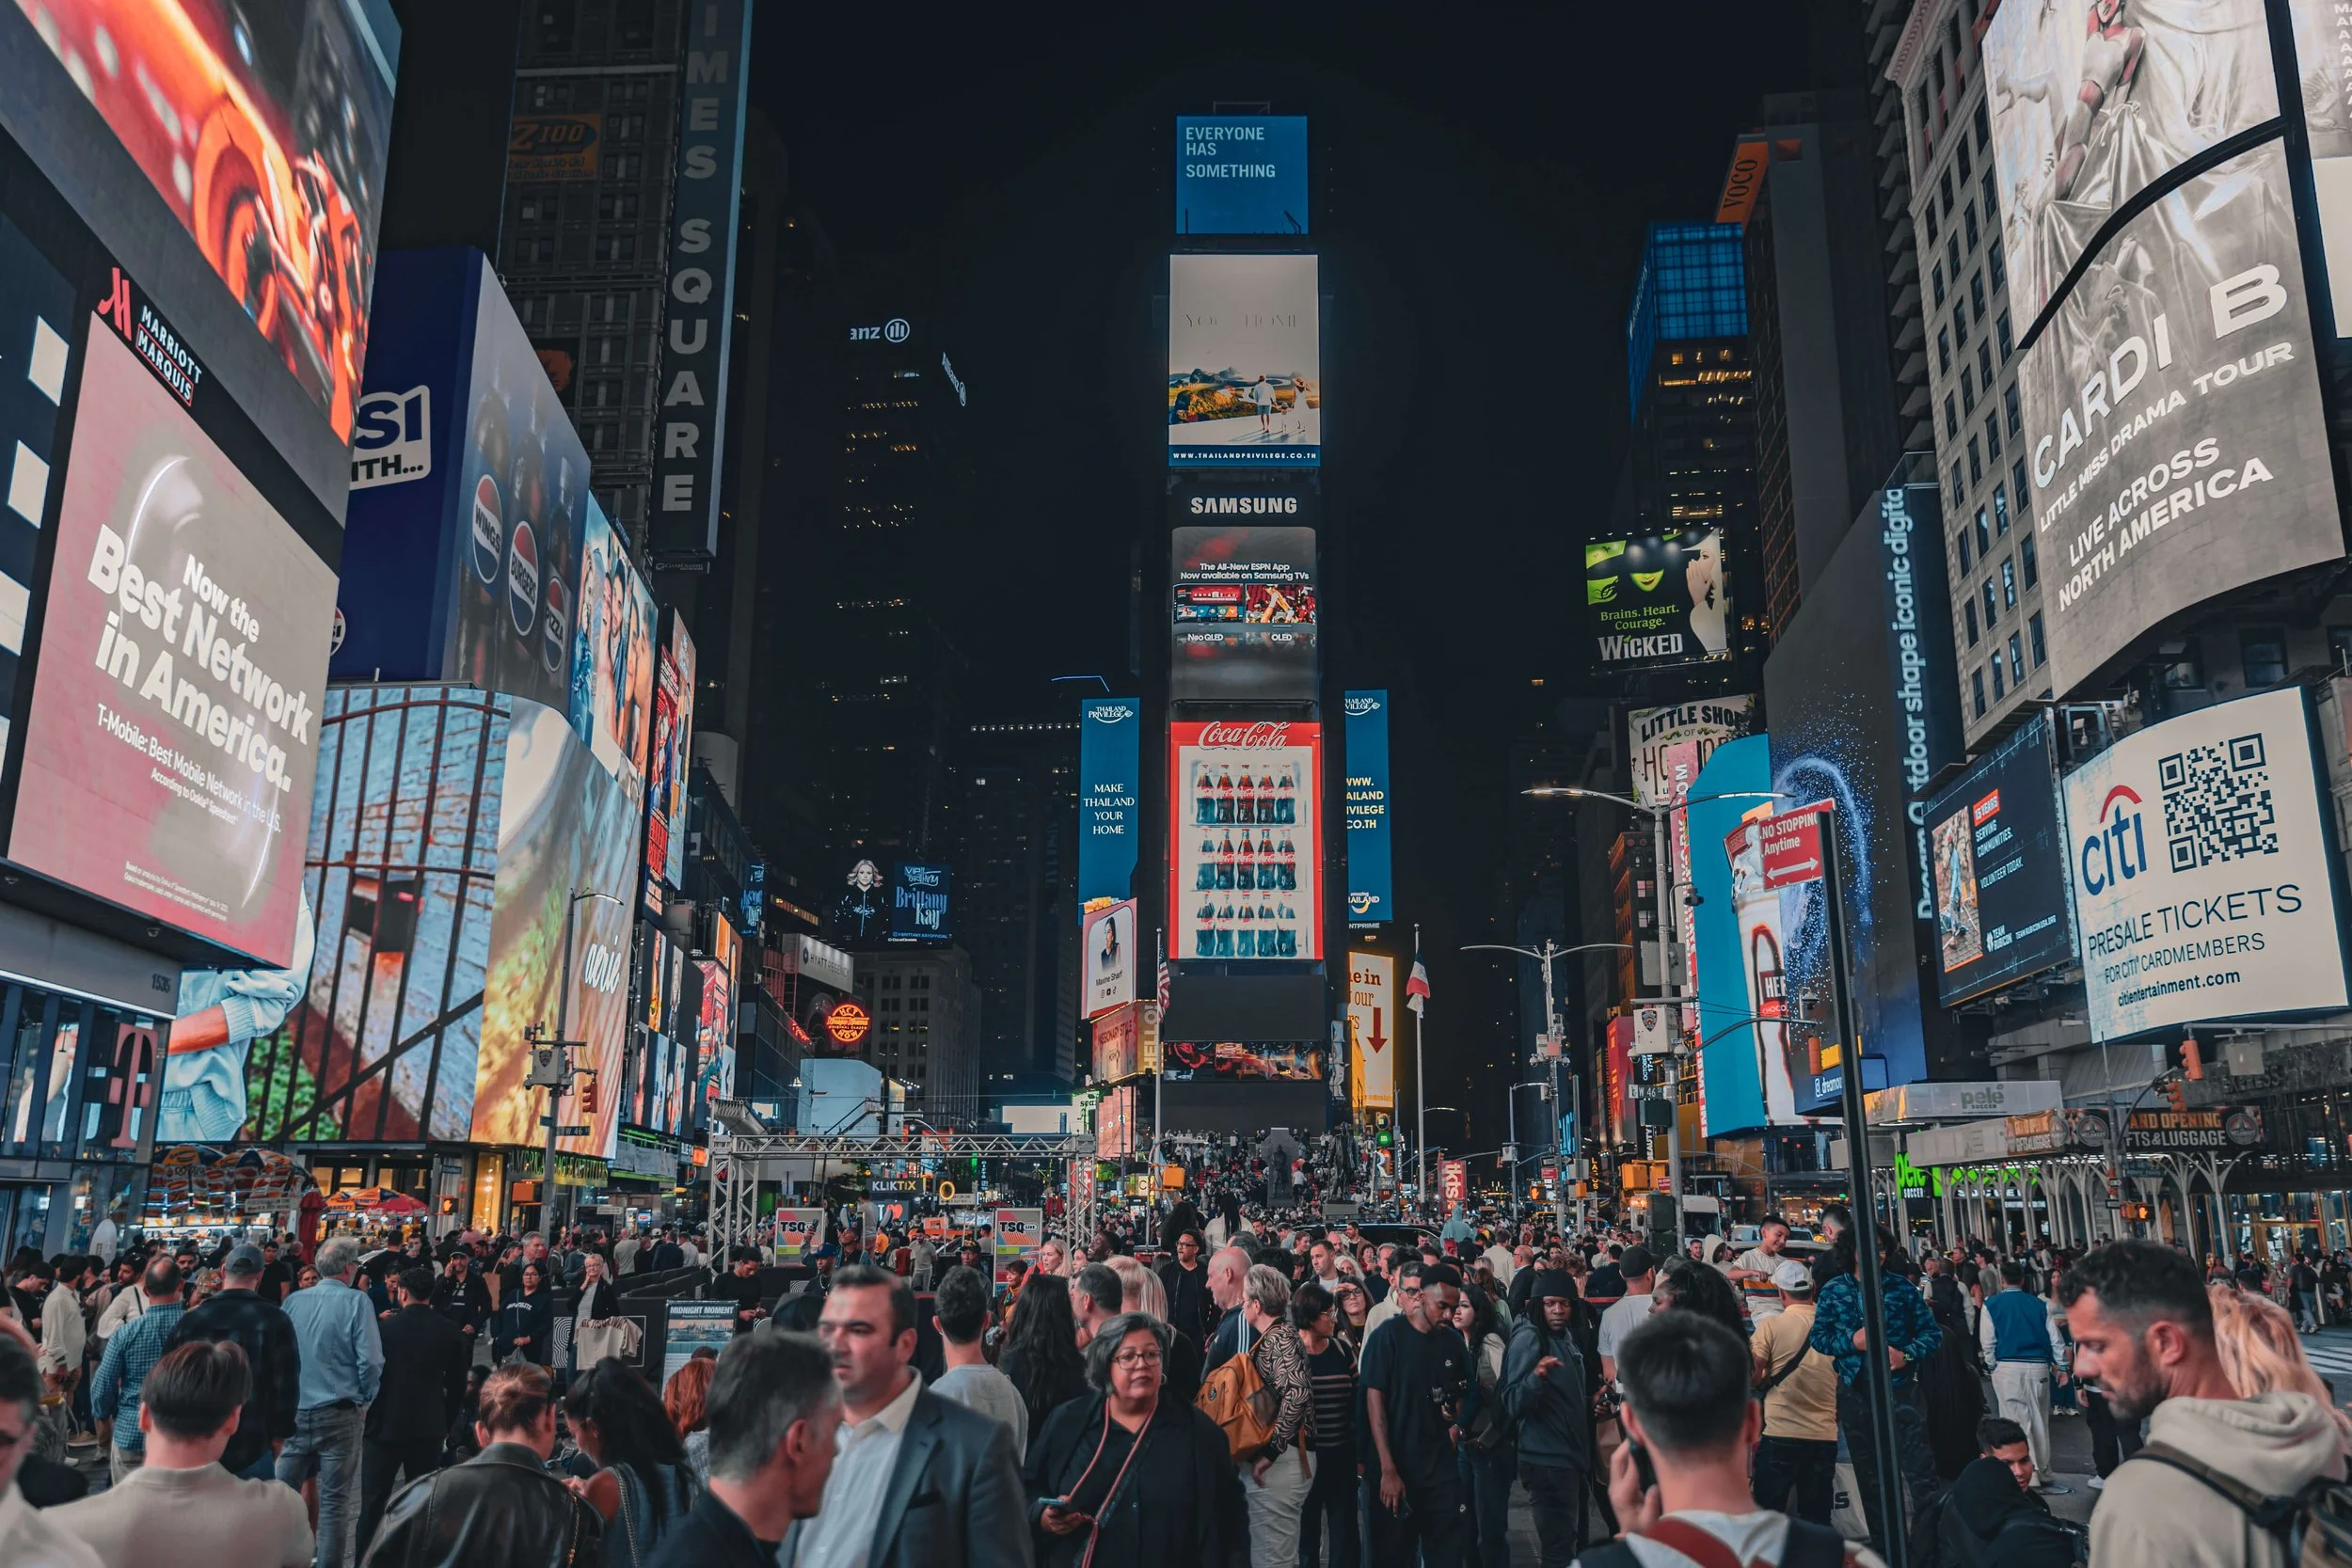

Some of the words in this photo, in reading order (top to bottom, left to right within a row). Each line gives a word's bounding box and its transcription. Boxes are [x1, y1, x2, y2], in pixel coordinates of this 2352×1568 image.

[1185, 127, 1264, 140] EVERYONE
[1185, 142, 1216, 156] HAS
[1185, 164, 1276, 178] SOMETHING
[140, 304, 202, 384] MARRIOTT
[136, 332, 193, 400] MARQUIS
[662, 218, 713, 511] SQUARE
[2033, 313, 2172, 488] CARDI
[2209, 263, 2287, 341] B
[2040, 483, 2077, 532] LITTLE
[2078, 447, 2108, 491] MISS
[2110, 390, 2187, 456] DRAMA
[2192, 341, 2295, 397] TOUR
[1190, 497, 1297, 514] SAMSUNG
[2070, 513, 2106, 568] LIVE
[2107, 436, 2220, 531] ACROSS
[475, 501, 501, 555] WINGS
[2058, 547, 2115, 612] NORTH
[2120, 457, 2274, 558] AMERICA
[511, 550, 537, 606] BURGERS
[1200, 562, 1216, 571] The
[1216, 562, 1249, 571] All-New
[1251, 562, 1271, 571] ESPN
[1272, 562, 1290, 573] App
[1201, 571, 1240, 579] available
[1253, 572, 1293, 581] Samsung
[183, 553, 230, 615] Now
[230, 597, 260, 642] the
[1892, 564, 1913, 631] iconic
[1599, 609, 1641, 622] Brains.
[1643, 603, 1679, 617] Heart.
[1614, 616, 1665, 630] Courage.
[87, 523, 183, 644] Best
[182, 601, 313, 746] Network
[545, 608, 564, 644] PIZZA
[1187, 633, 1203, 641] Neo
[1271, 633, 1292, 641] OLED
[1897, 631, 1926, 711] shape
[95, 610, 140, 689] in
[139, 650, 292, 793] America.
[1198, 721, 1292, 751] Coca-Cola
[1641, 705, 1697, 743] LITTLE
[98, 703, 149, 753] T-Mobile:
[149, 736, 173, 768] Best
[173, 751, 206, 787] Mobile
[205, 771, 243, 810] Network
[251, 803, 266, 824] the
[151, 768, 183, 798] According
[1094, 784, 1124, 793] MAKE
[1083, 798, 1135, 807] THAILAND
[1094, 811, 1123, 820] YOUR
[1092, 825, 1124, 834] HOME
[1761, 827, 1774, 840] NO
[1976, 819, 1997, 842] SERVING
[1764, 836, 1801, 856] Anytime
[1977, 827, 2013, 858] COMMUNITIES.
[2081, 804, 2147, 896] citi
[1980, 863, 2007, 889] VOLUNTEER
[2006, 857, 2024, 876] TODAY.
[896, 886, 947, 914] Brittany
[914, 903, 940, 930] Kay
[2089, 912, 2153, 960] PRESALE
[2156, 883, 2303, 934] TICKETS
[1993, 925, 2006, 939] TEAM
[584, 935, 621, 994] aerie
[810, 953, 827, 969] HYATT
[2105, 959, 2122, 984] FOR
[2140, 932, 2265, 973] CARDMEMBERS
[1095, 975, 1110, 987] Maxine
[1364, 968, 1382, 986] in
[2118, 968, 2242, 1007] citientertainment.com
[1355, 990, 1375, 1007] our
[1638, 1086, 1645, 1097] W
[1646, 1086, 1656, 1098] 46
[2160, 1111, 2221, 1129] OPENING
[2161, 1129, 2227, 1147] LUGGAGE
[1443, 1162, 1462, 1202] tkts
[1903, 1187, 1924, 1198] SOCCER
[780, 1221, 805, 1233] TSQ
[999, 1221, 1025, 1234] TSQ
[670, 1306, 702, 1315] MIDNIGHT
[704, 1306, 734, 1315] MOMENT
